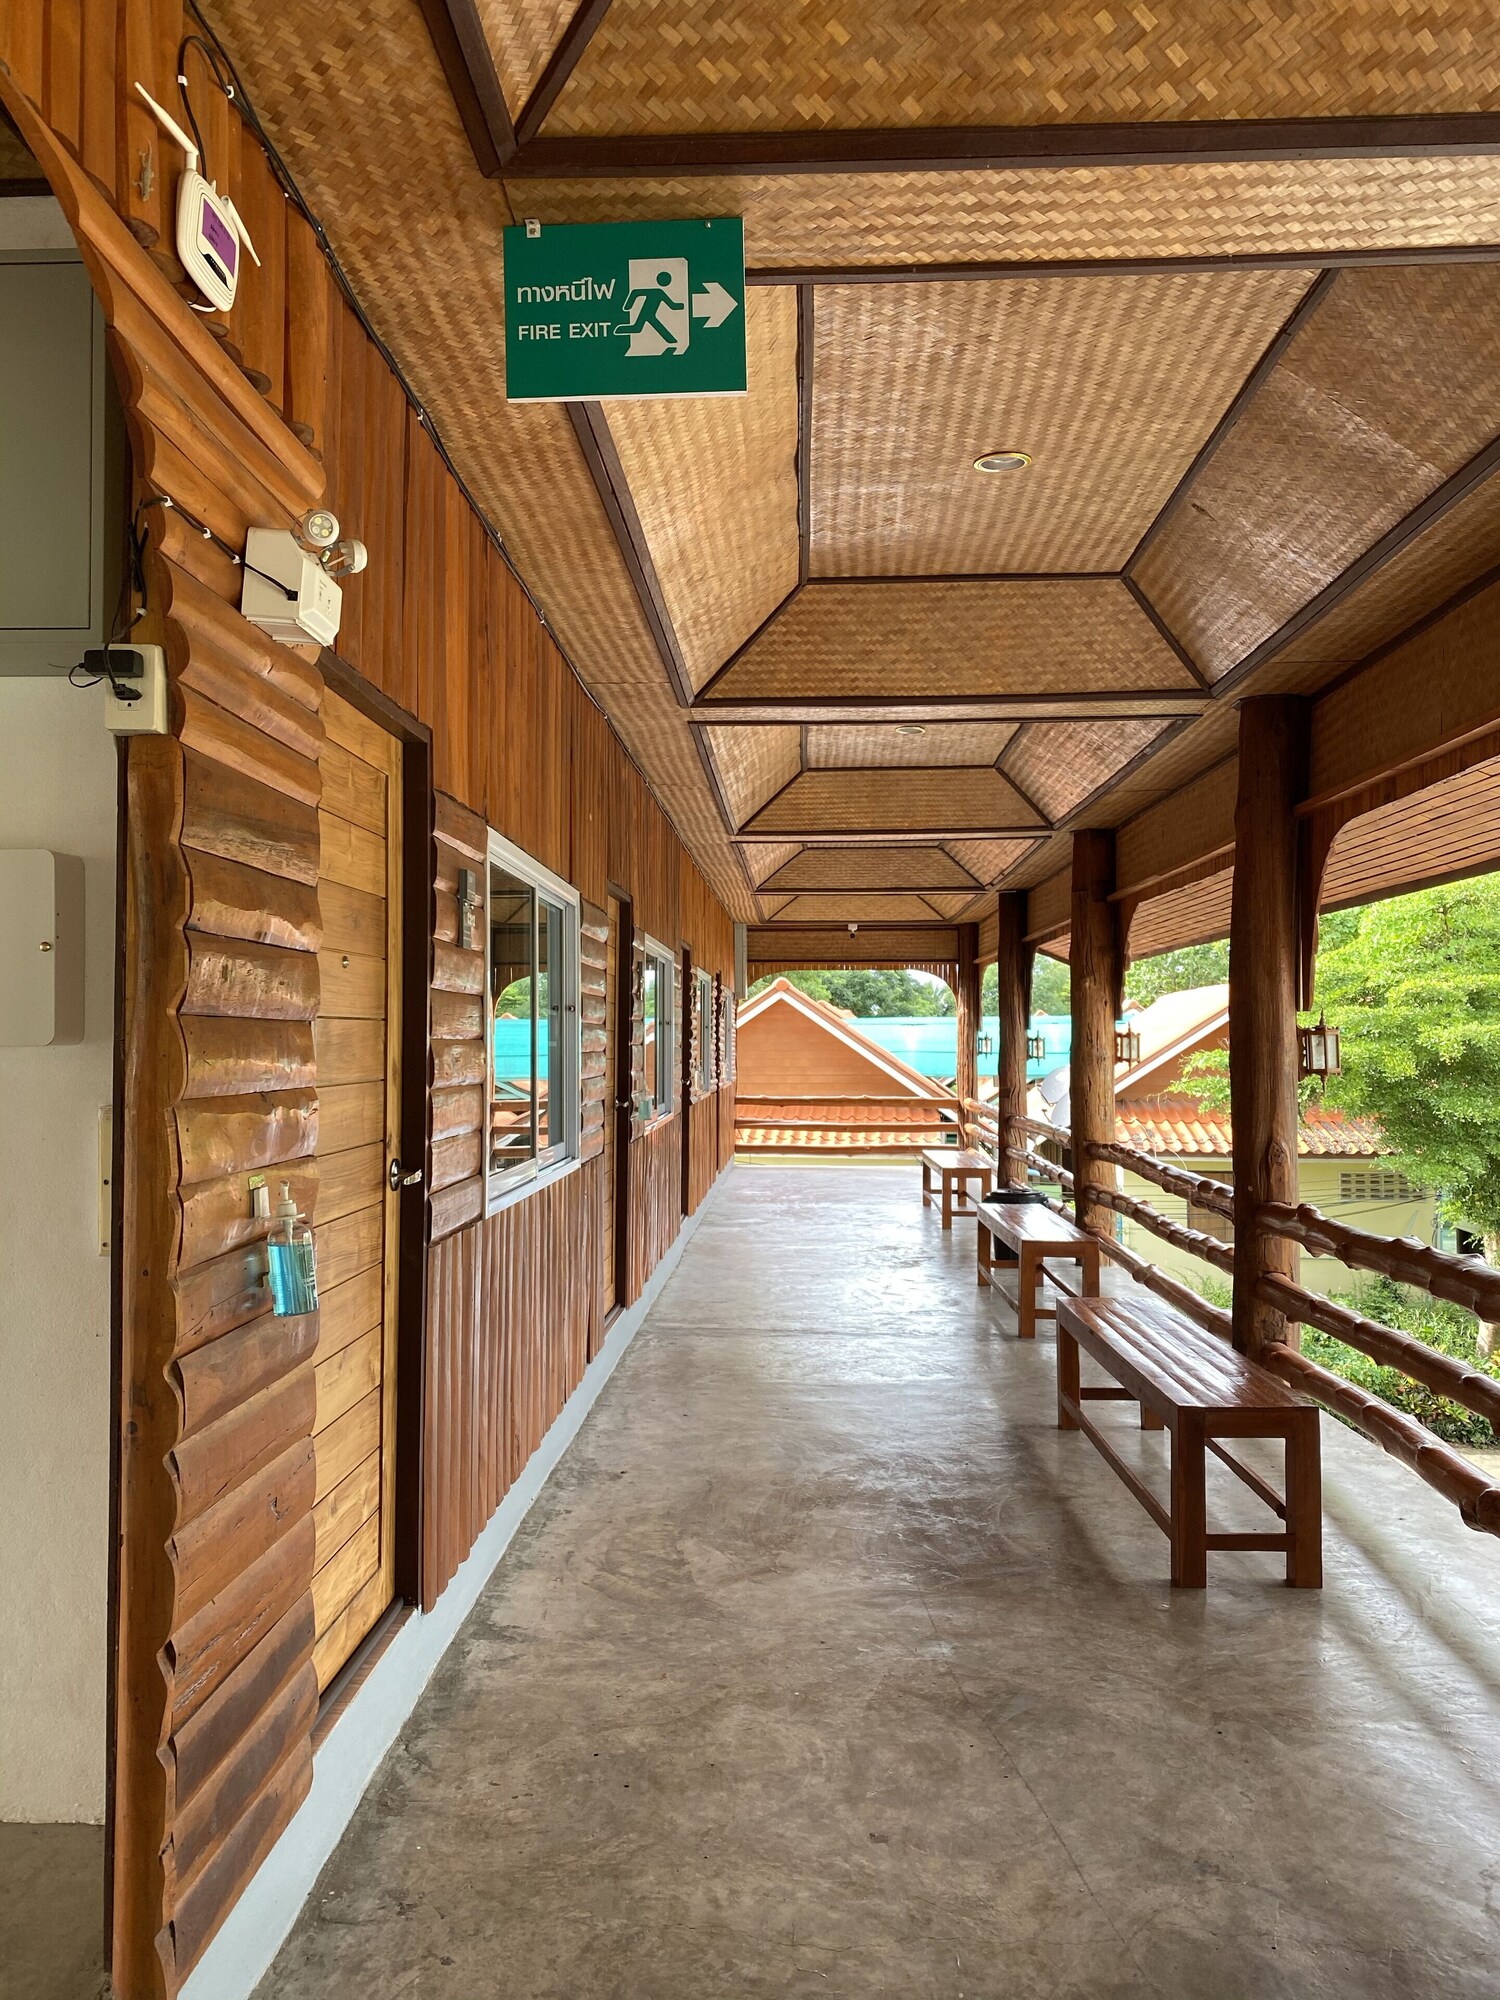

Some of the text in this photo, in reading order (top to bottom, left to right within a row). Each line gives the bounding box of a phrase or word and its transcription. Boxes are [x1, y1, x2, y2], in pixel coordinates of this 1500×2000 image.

[517, 276, 616, 303] ทางหนีไฟ
[518, 322, 612, 340] FIRE EXIT
